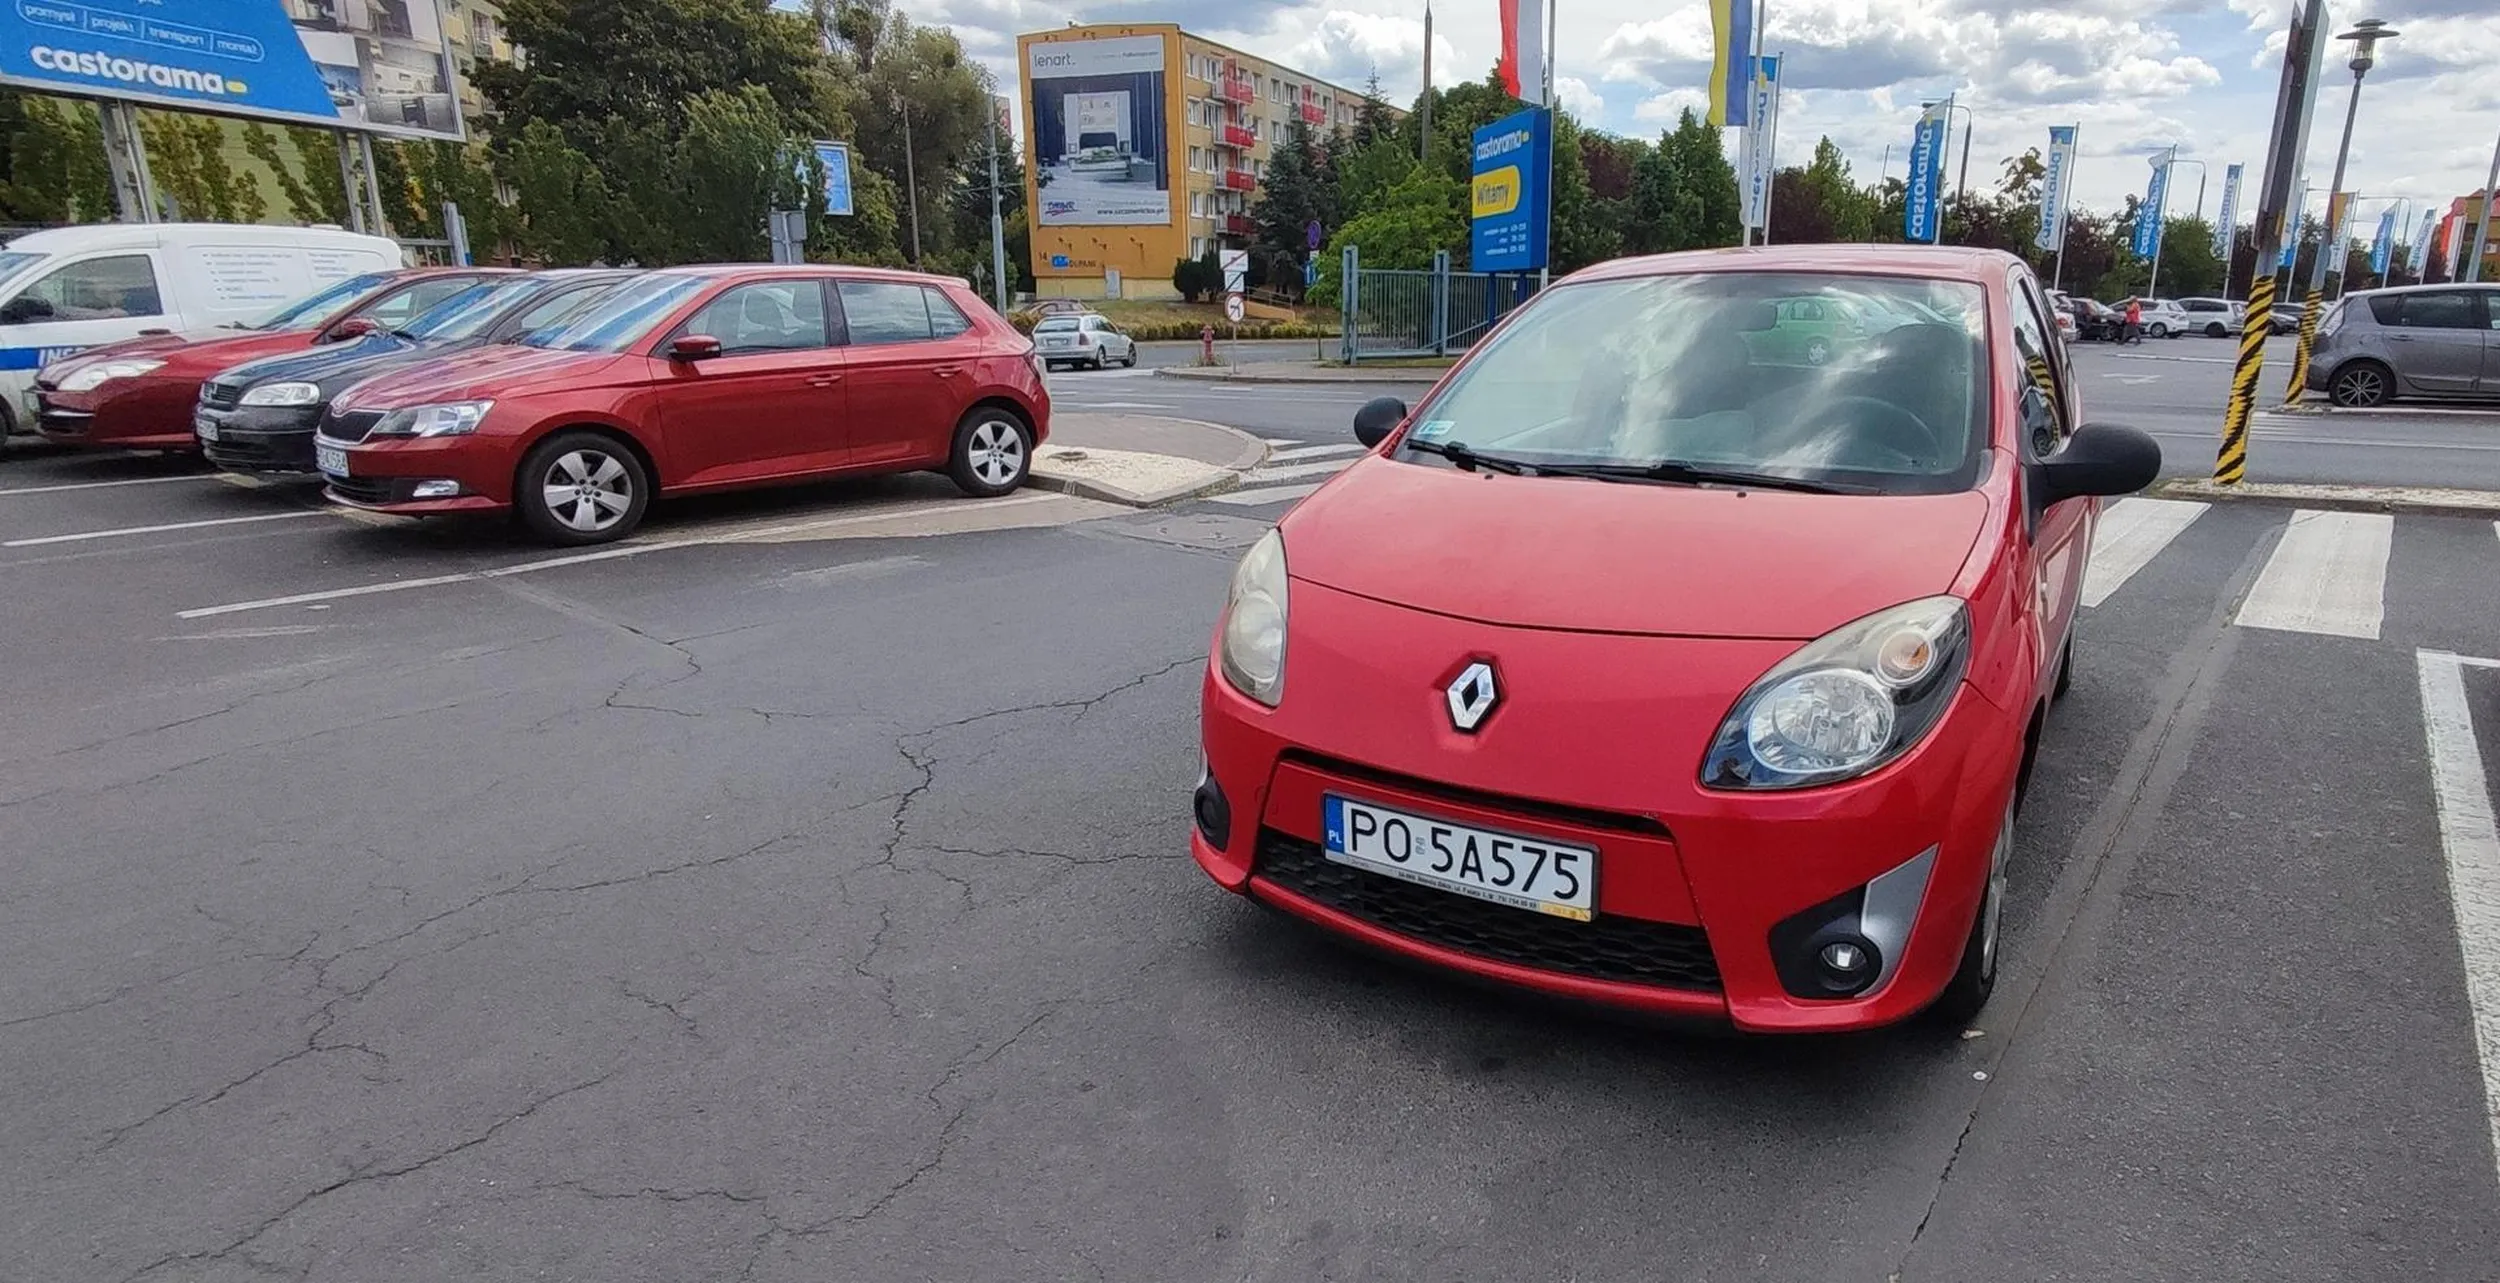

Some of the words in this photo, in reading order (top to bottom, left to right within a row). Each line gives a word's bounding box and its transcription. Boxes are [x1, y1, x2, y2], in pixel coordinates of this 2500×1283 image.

[30, 45, 224, 94] castorama
[1476, 129, 1522, 161] castorama
[1475, 182, 1510, 208] Witamy
[1328, 829, 1342, 844] PL
[1351, 808, 1411, 863] PO
[1431, 827, 1579, 900] 5A575
